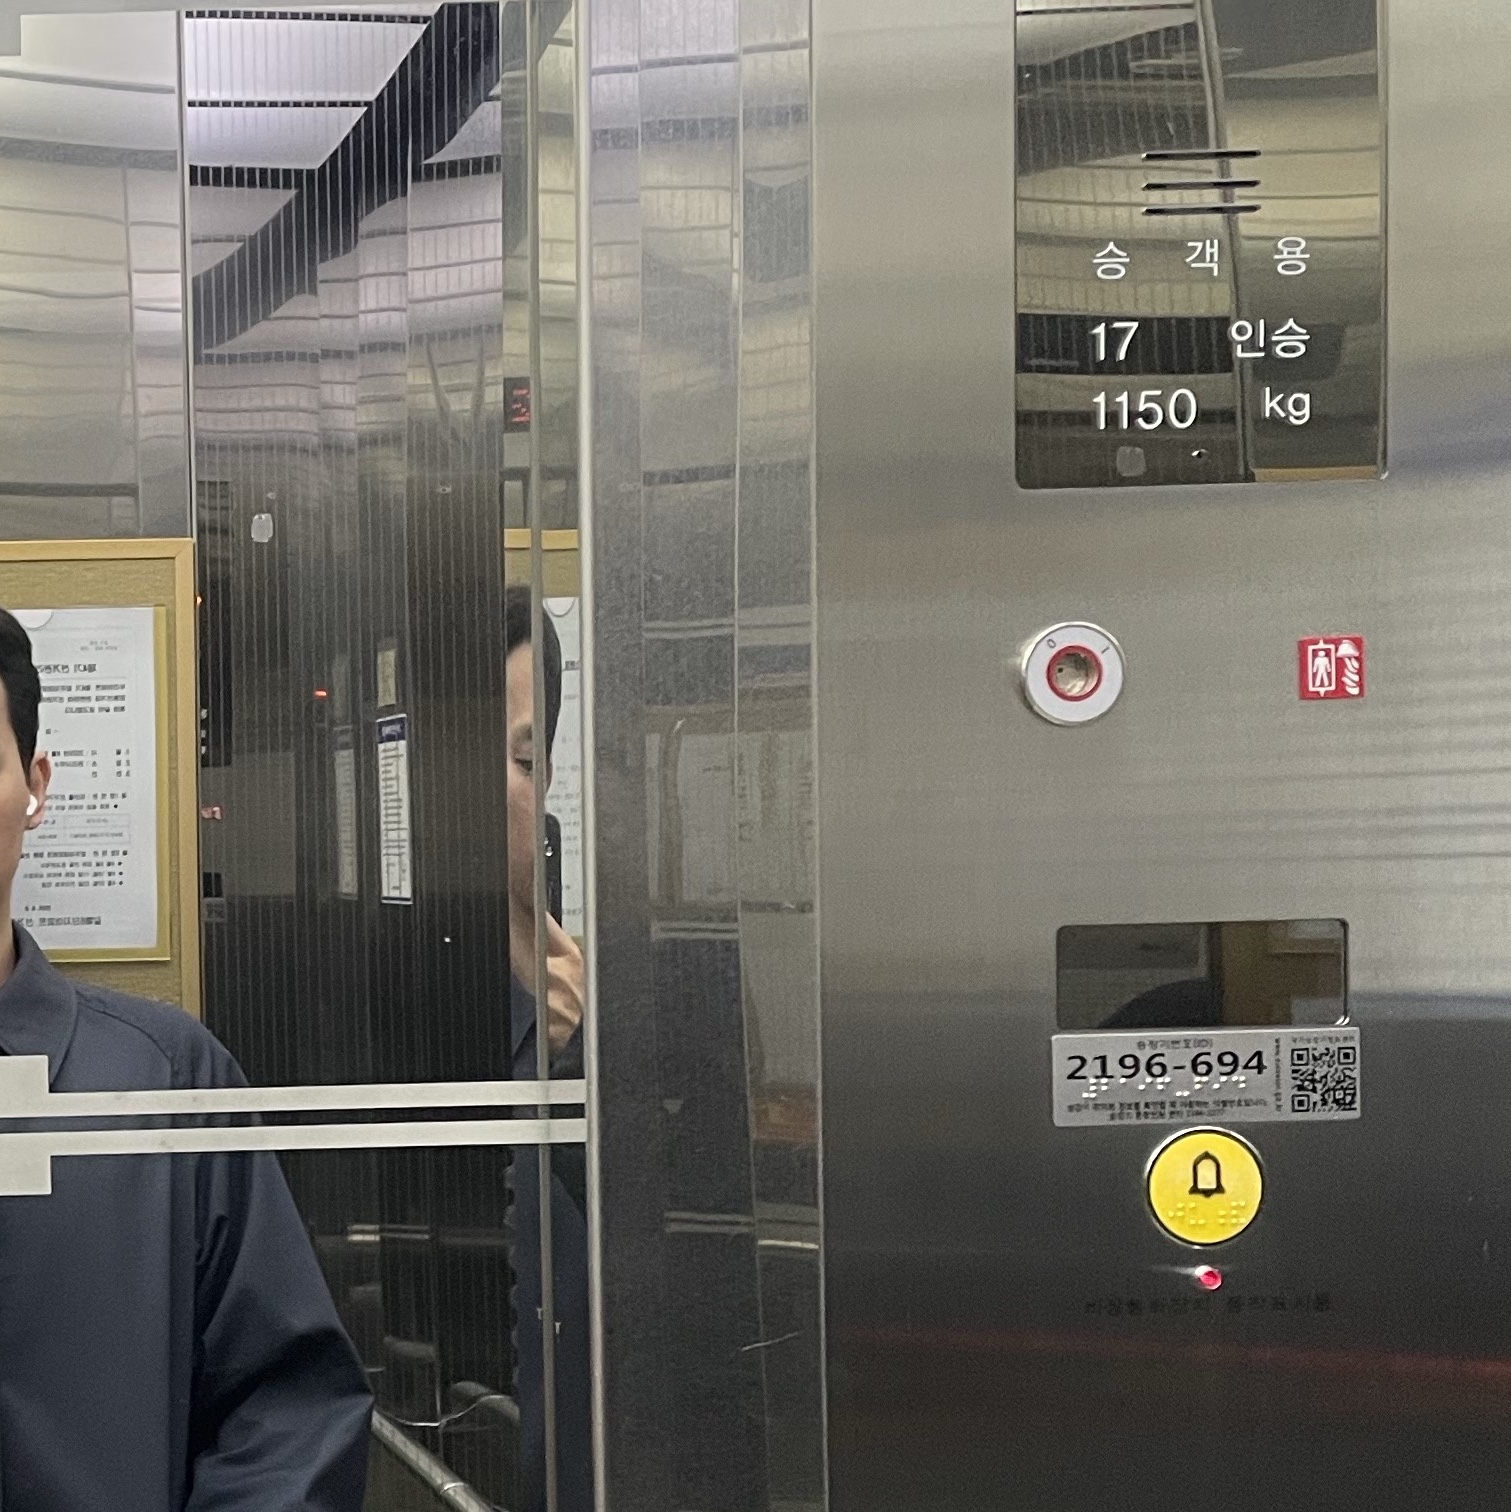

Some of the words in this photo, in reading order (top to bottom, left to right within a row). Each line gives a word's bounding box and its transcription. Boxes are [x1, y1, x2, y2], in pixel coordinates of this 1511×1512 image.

[1092, 241, 1130, 280] 승
[1186, 238, 1219, 277] 객
[1274, 236, 1311, 275] 용
[1091, 321, 1139, 361] 17
[1229, 318, 1311, 359] 인승
[1092, 388, 1197, 431] 1150
[1264, 386, 1311, 426] kg
[1066, 1050, 1268, 1080] 2196-694
